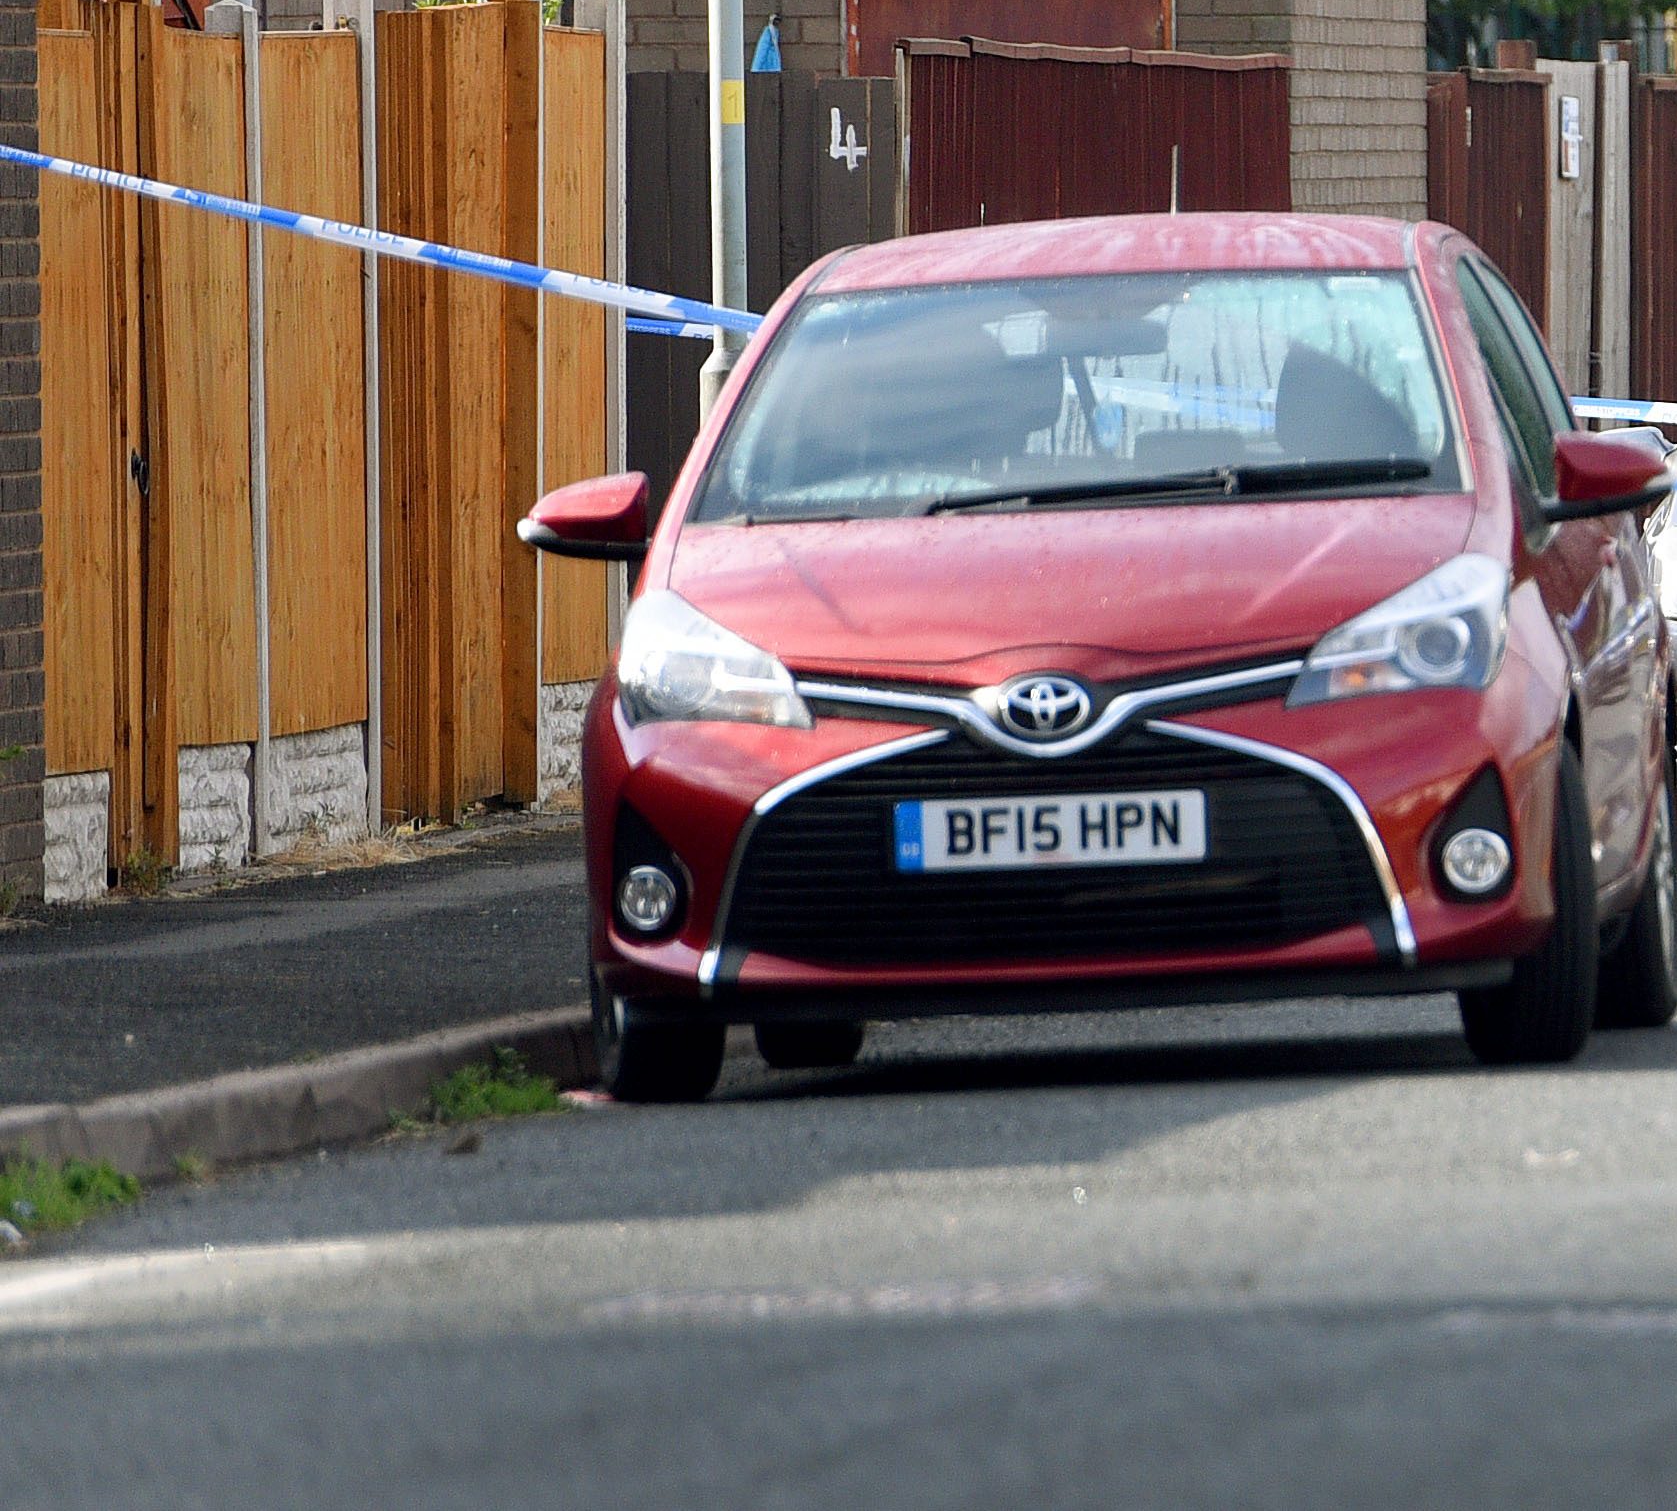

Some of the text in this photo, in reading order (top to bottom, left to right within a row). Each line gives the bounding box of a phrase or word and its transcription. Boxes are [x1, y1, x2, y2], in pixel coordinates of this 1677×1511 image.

[829, 107, 868, 171] 4
[946, 799, 1181, 856] BF15 HPN
